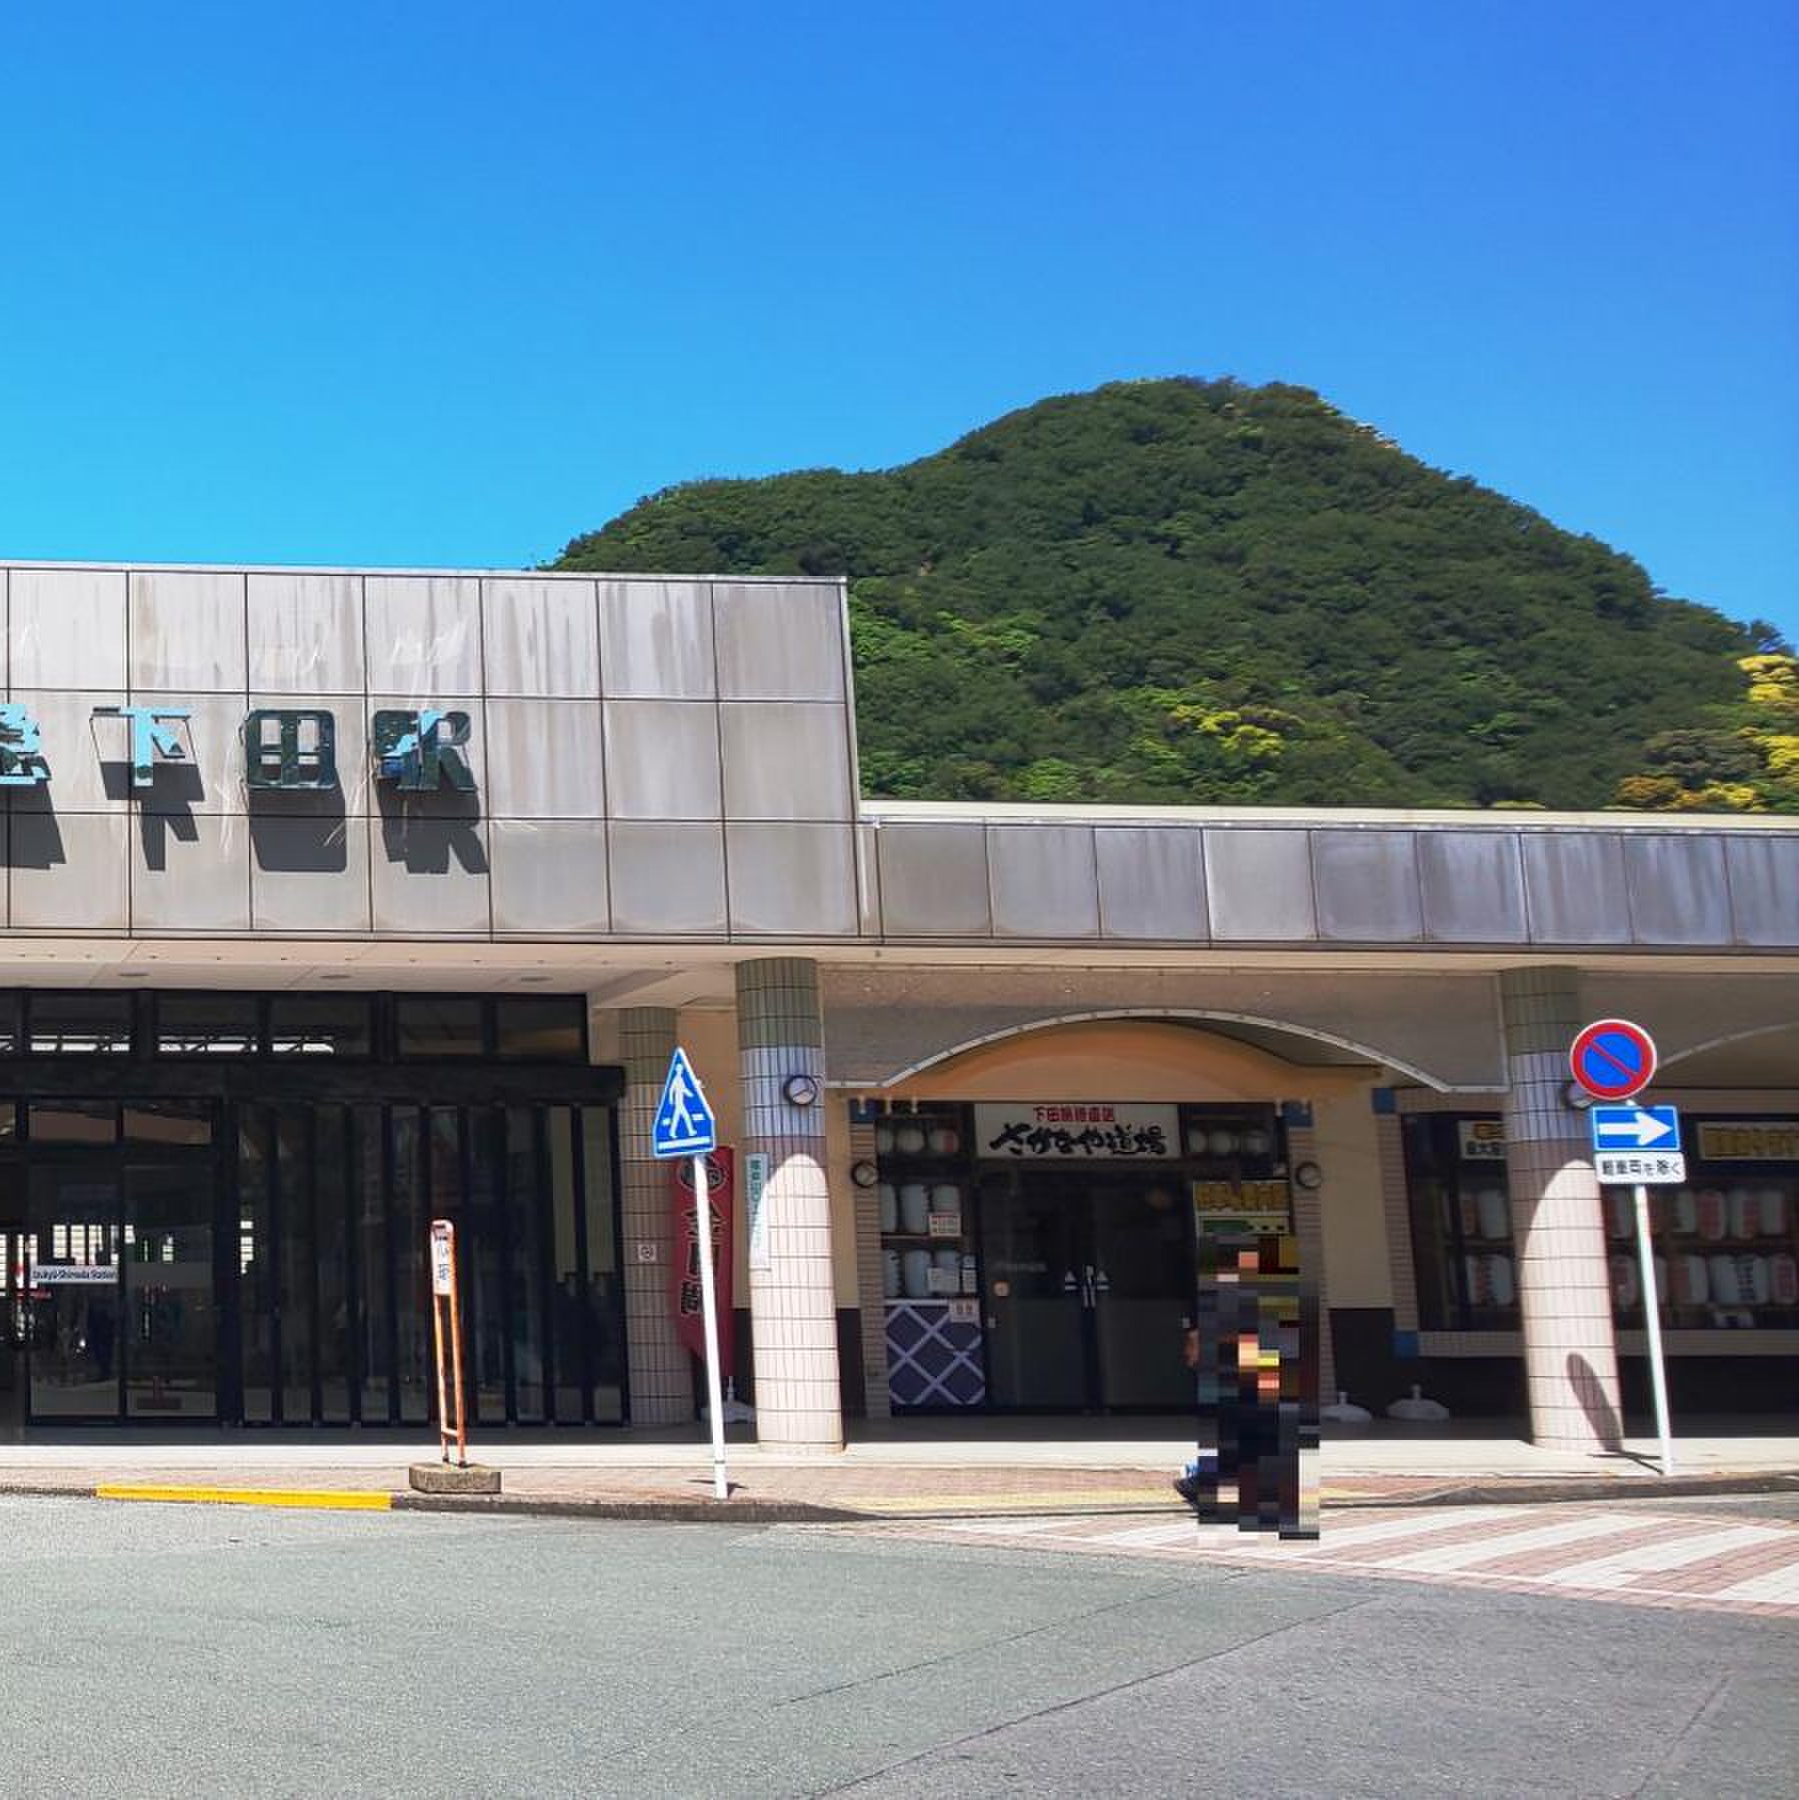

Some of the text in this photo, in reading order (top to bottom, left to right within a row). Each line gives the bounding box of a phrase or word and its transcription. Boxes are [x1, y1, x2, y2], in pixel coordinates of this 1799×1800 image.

[989, 1122, 1167, 1155] さかなや道場
[1602, 1158, 1682, 1176] 軽車両を除く
